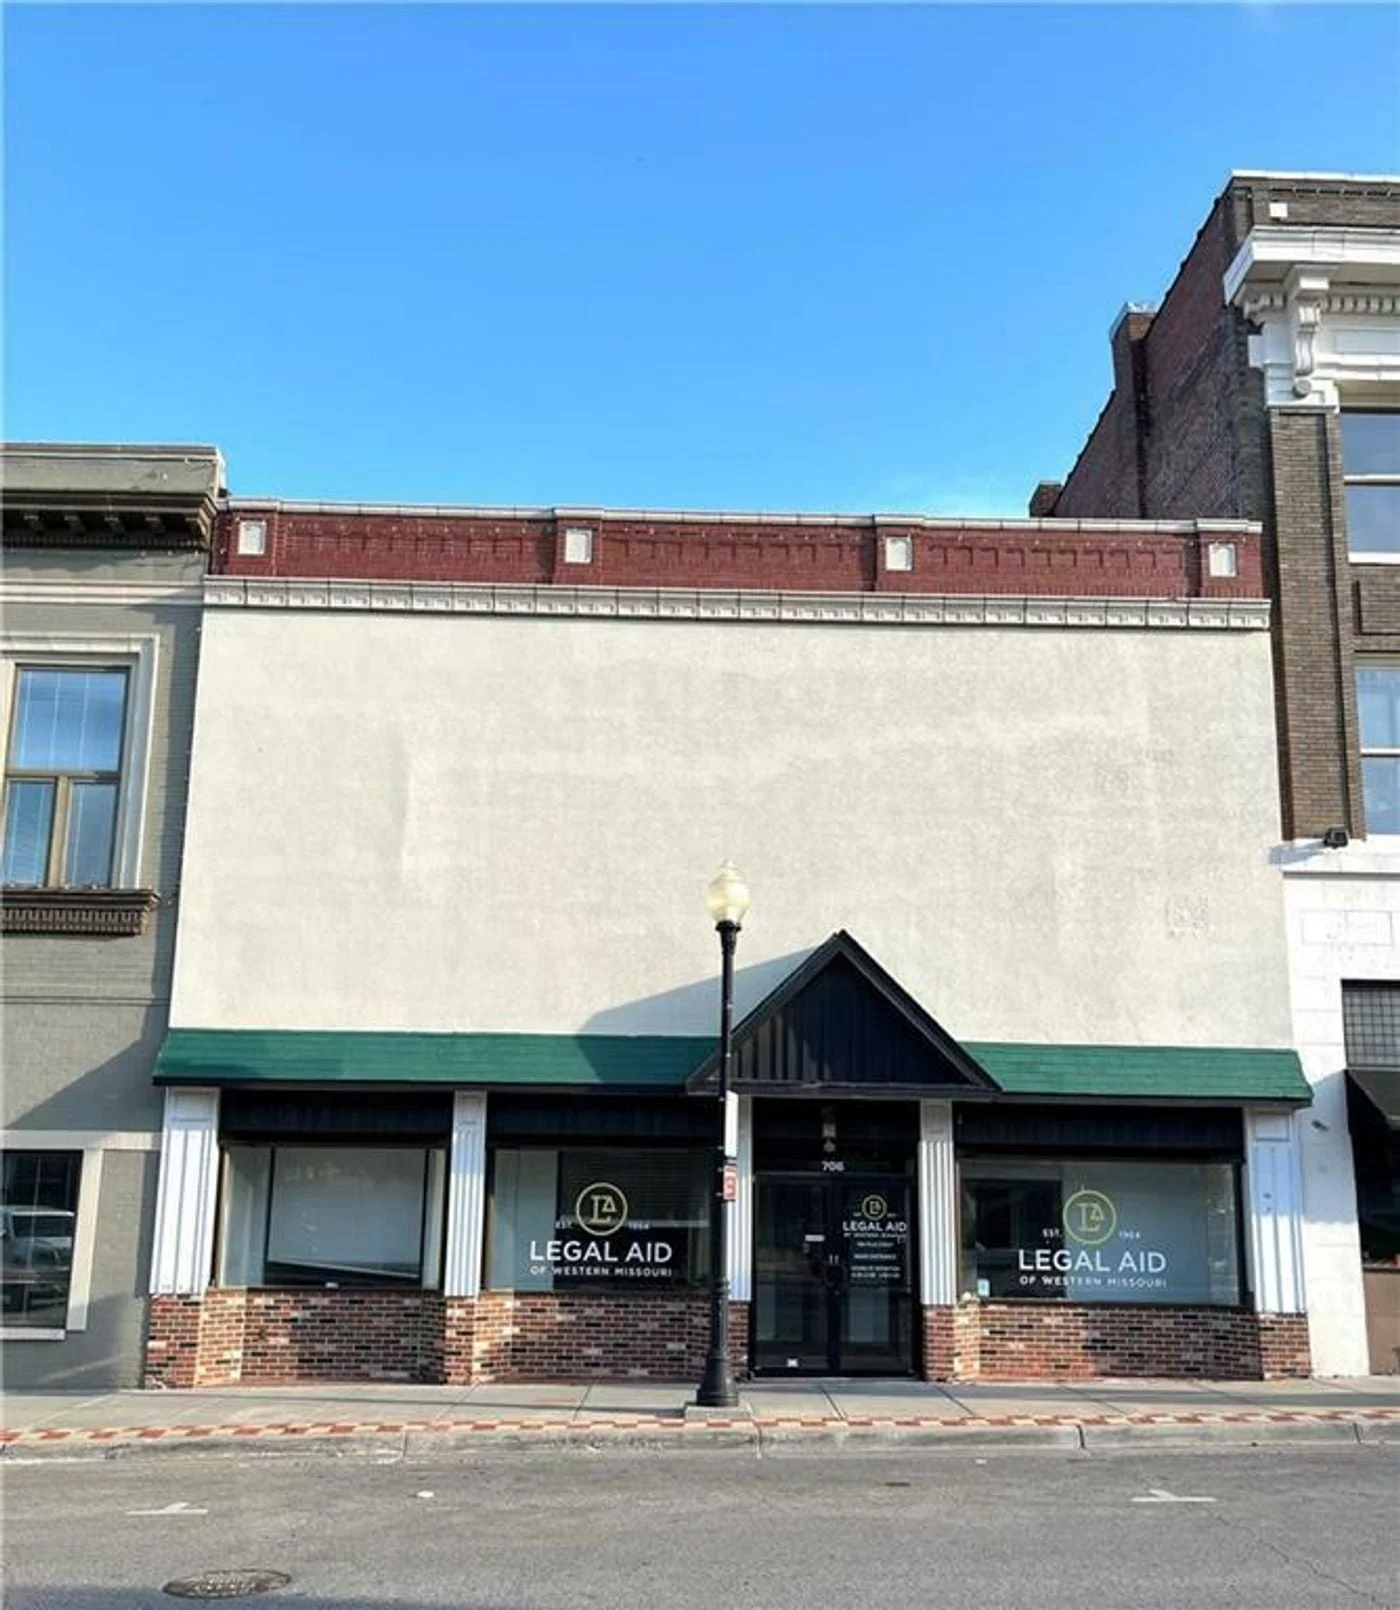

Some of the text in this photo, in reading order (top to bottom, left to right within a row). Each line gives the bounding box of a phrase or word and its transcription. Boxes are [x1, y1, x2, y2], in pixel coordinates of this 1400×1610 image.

[842, 1220, 908, 1232] LEGAL AID
[529, 1240, 673, 1263] LEGAL AID
[1018, 1249, 1167, 1273] LEGAL AID
[530, 1265, 672, 1278] OF WESTERN MISSOURI
[1019, 1275, 1167, 1288] OF WESTERN MISSOURI
